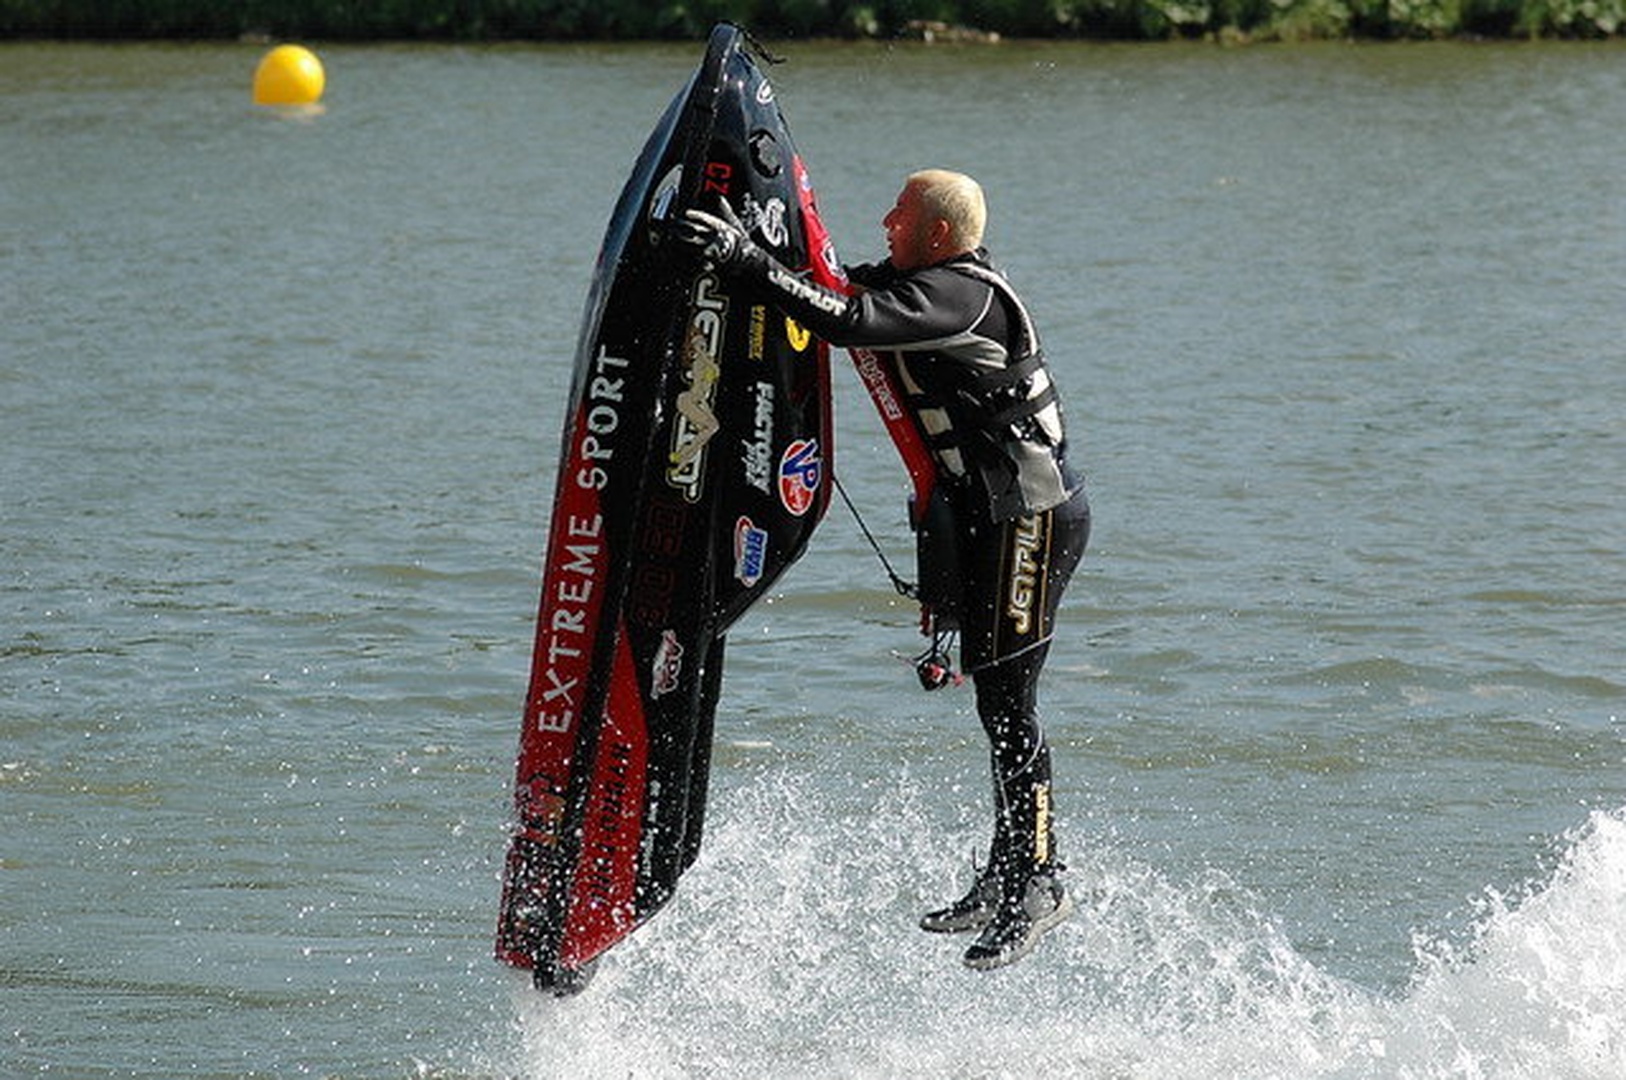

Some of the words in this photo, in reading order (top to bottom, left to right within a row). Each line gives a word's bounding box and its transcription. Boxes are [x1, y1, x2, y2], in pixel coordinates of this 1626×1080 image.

[705, 162, 732, 195] CZ
[755, 381, 775, 495] FACTORY
[782, 438, 821, 492] VP
[538, 514, 602, 733] EXTREME
[577, 344, 630, 491] SPORT
